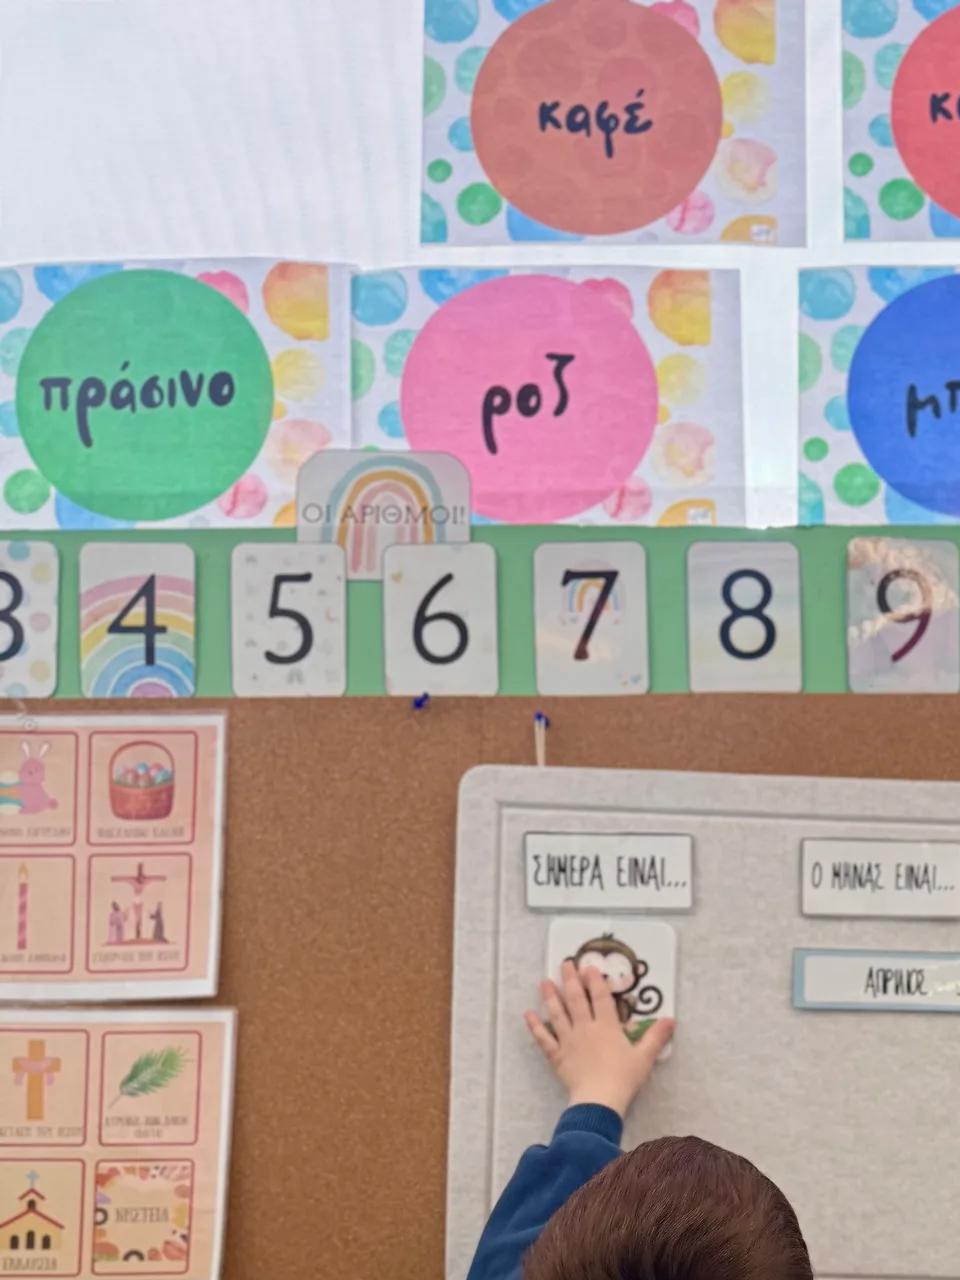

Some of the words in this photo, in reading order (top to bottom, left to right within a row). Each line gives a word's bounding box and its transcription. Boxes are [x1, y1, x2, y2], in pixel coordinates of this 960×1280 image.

[538, 88, 654, 159] καφέ
[39, 360, 236, 449] πράσινο
[481, 352, 576, 455] ροζ
[302, 503, 332, 523] ΟΙ
[340, 503, 466, 526] ΑΡΙΘΜΟΙ!
[106, 574, 168, 668] 4
[264, 571, 314, 665] 5
[412, 572, 470, 665] 6
[560, 568, 620, 661] 7
[719, 568, 777, 661] 8
[875, 569, 932, 663] 9
[532, 853, 604, 891] ΣΗΜΕΡΑ
[616, 855, 688, 892] ΕΙΝΑΙ...
[810, 861, 824, 890] Ο
[831, 862, 884, 891] ΜΗΝΑΣ
